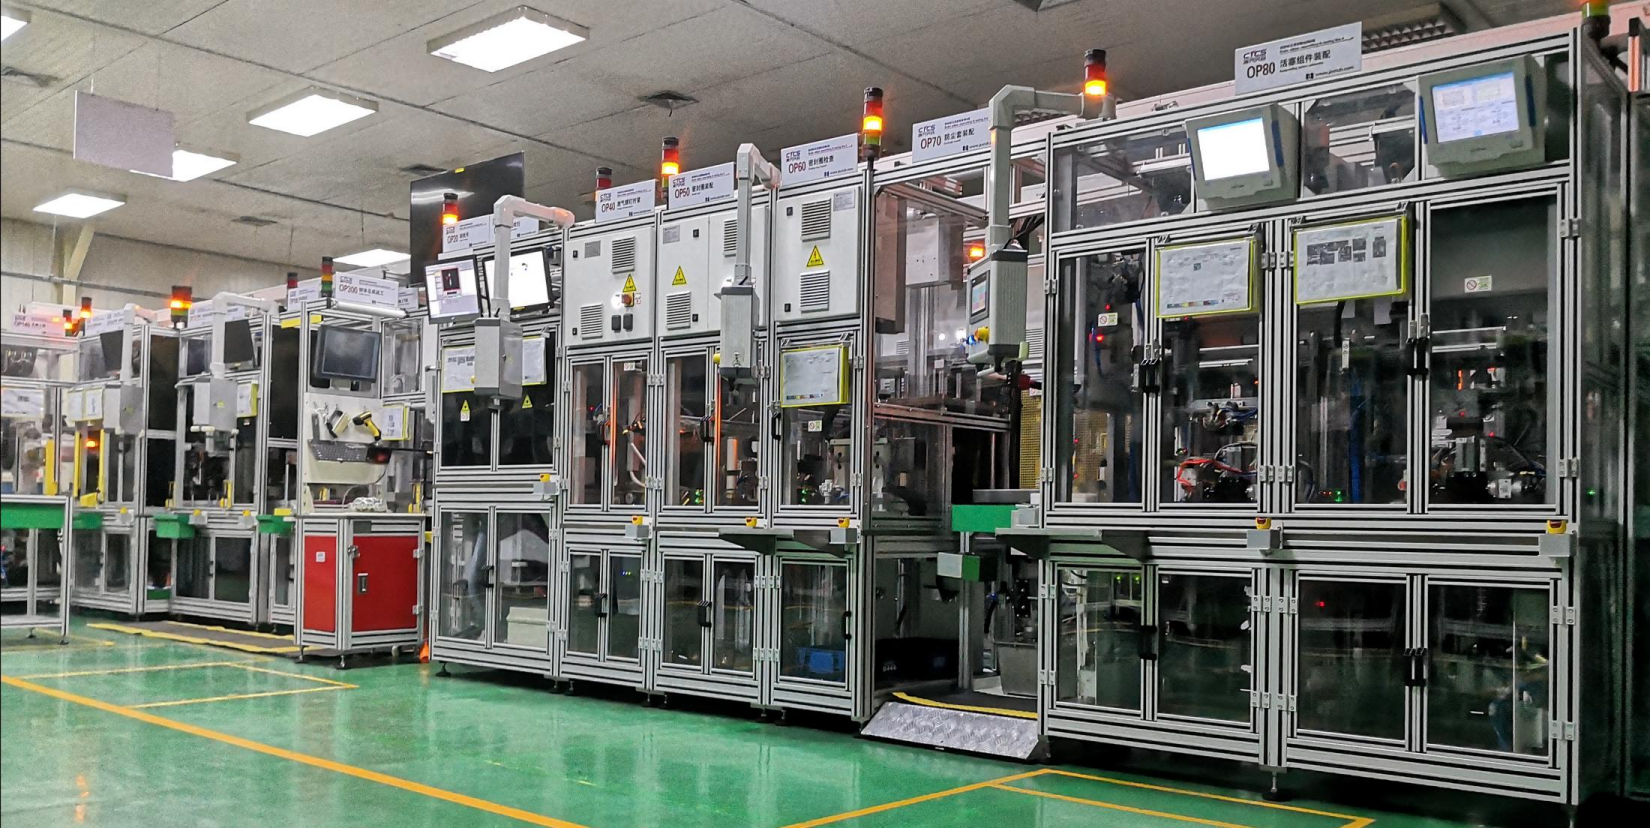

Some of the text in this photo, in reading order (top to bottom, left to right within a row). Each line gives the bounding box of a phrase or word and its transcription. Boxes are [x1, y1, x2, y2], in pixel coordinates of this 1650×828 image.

[1280, 49, 1331, 68] 活塞组件装配
[1246, 62, 1276, 79] OP80
[944, 128, 975, 141] 防尘套装配
[920, 135, 942, 149] OP70
[788, 161, 807, 174] OP60
[674, 187, 690, 199] OP50
[601, 202, 616, 213] OP40
